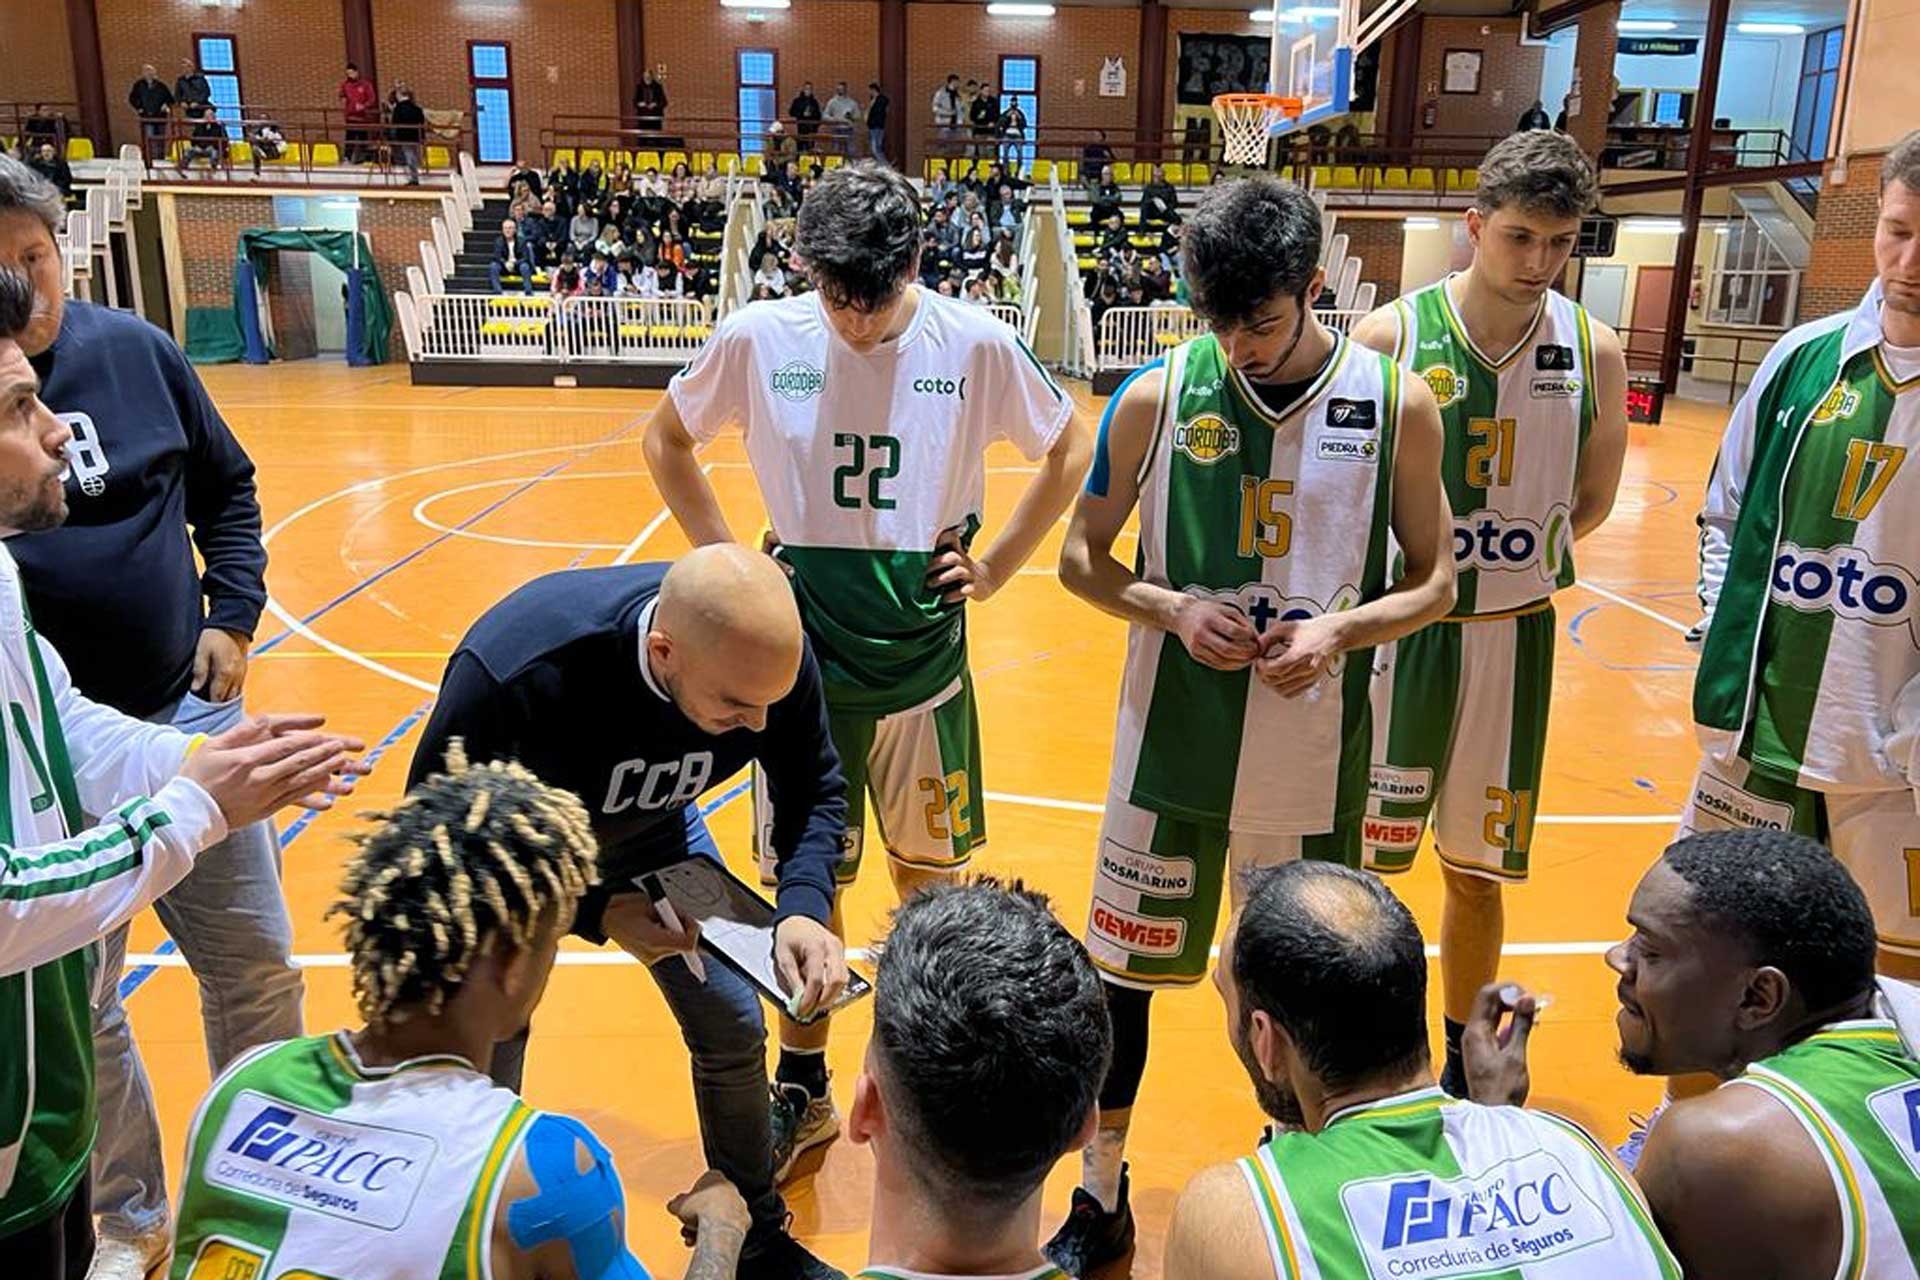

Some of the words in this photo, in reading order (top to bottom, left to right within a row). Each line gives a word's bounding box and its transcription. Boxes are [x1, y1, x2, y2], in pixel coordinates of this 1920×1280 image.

[913, 378, 956, 395] coto
[833, 433, 901, 510] 22
[1467, 418, 1517, 488] 21
[1832, 437, 1908, 521] 17
[1237, 476, 1295, 558] 15
[1454, 520, 1536, 562] oto
[1772, 553, 1908, 615] coto
[601, 751, 714, 815] CCB
[918, 770, 973, 840] 22
[1485, 786, 1531, 853] 21
[275, 1138, 414, 1193] PACC
[303, 1185, 359, 1213] Seguros
[1457, 1172, 1572, 1239] PACC
[1484, 1241, 1511, 1262] de
[1511, 1227, 1575, 1257] Seguros
